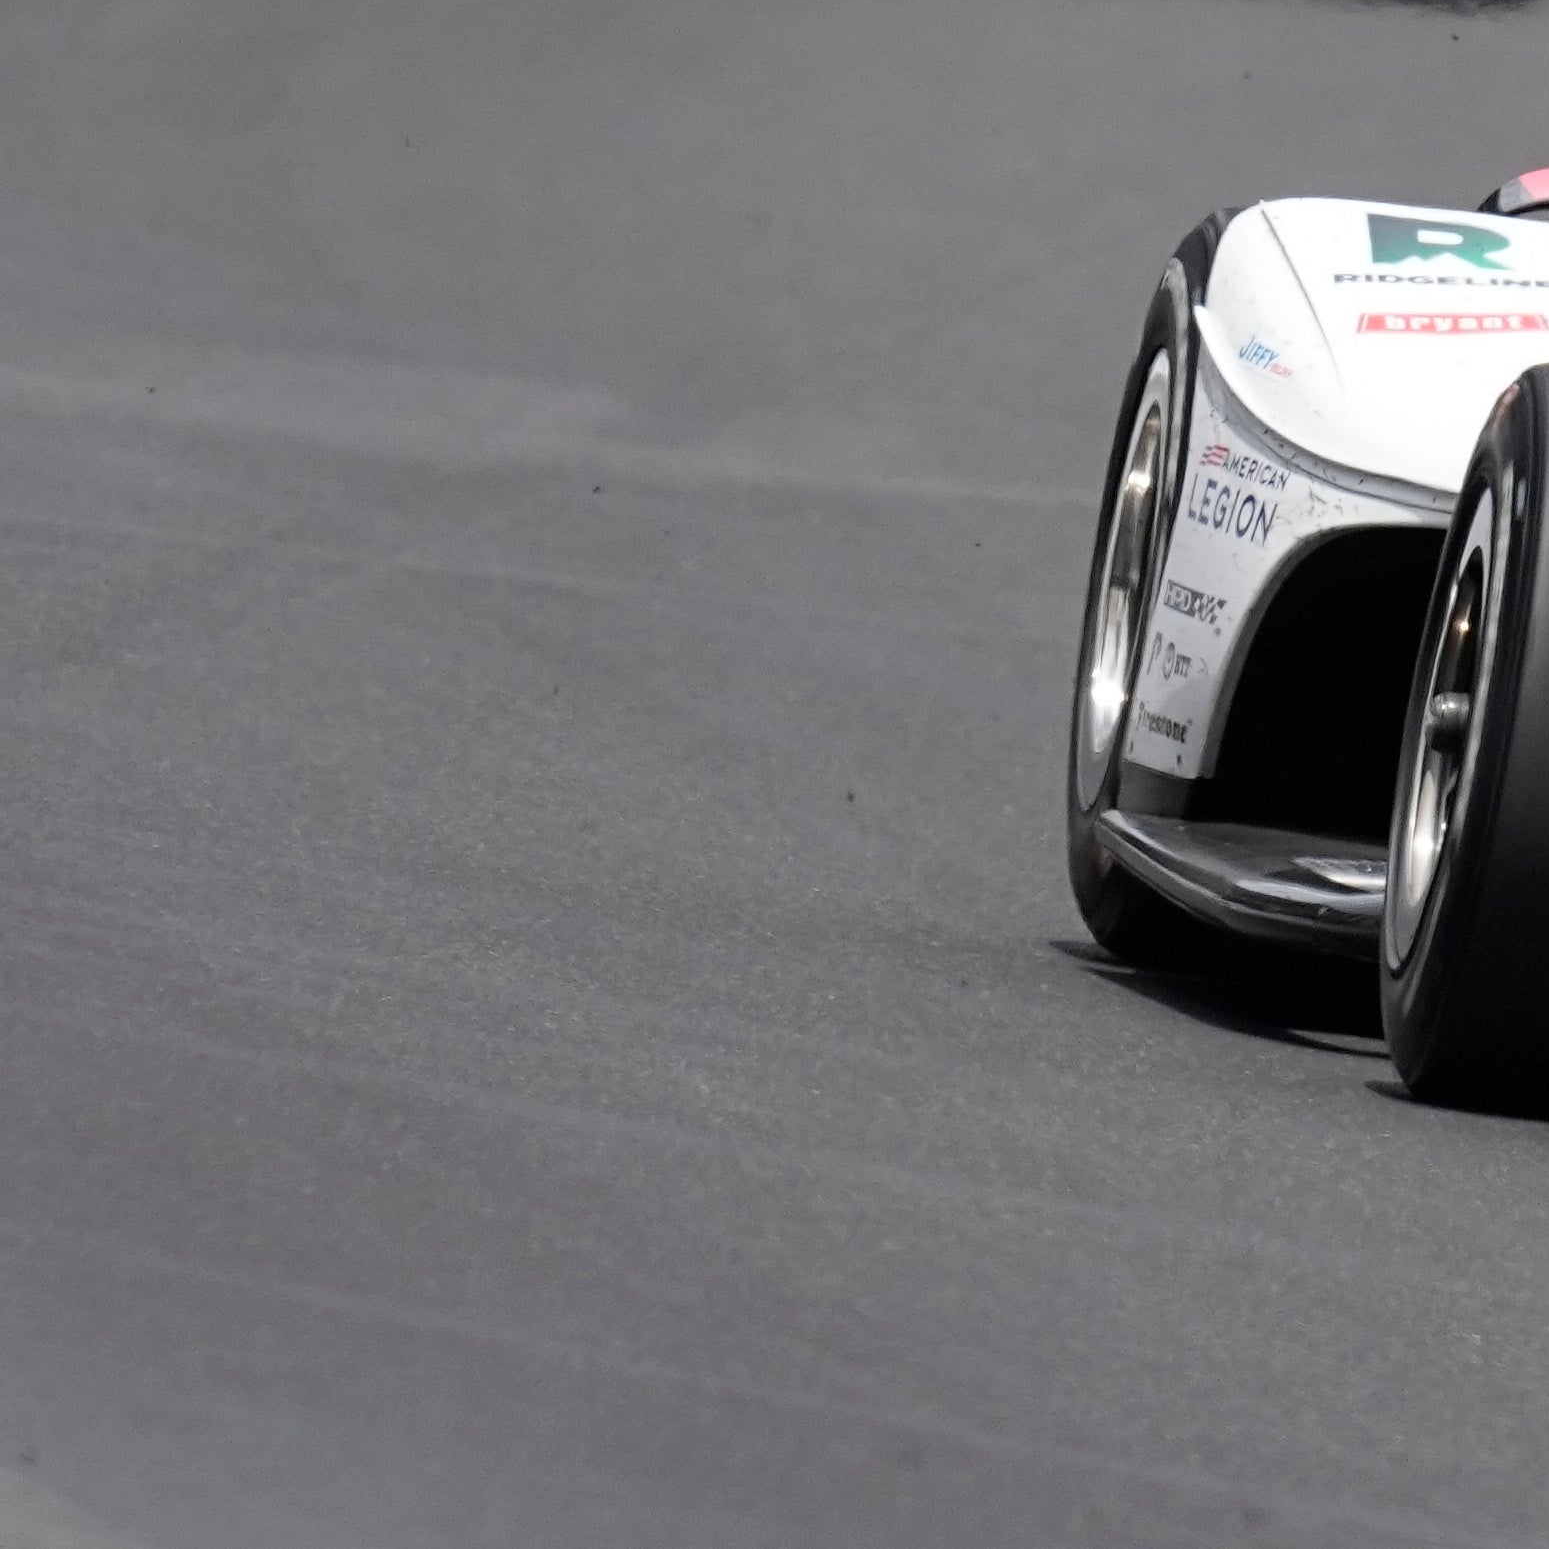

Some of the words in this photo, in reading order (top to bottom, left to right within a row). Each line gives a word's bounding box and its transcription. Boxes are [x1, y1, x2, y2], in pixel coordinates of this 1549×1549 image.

[1383, 314, 1524, 333] bryant
[1238, 336, 1278, 369] JIFFY
[1223, 449, 1291, 492] AMERICAN
[1188, 473, 1278, 546] LEGION
